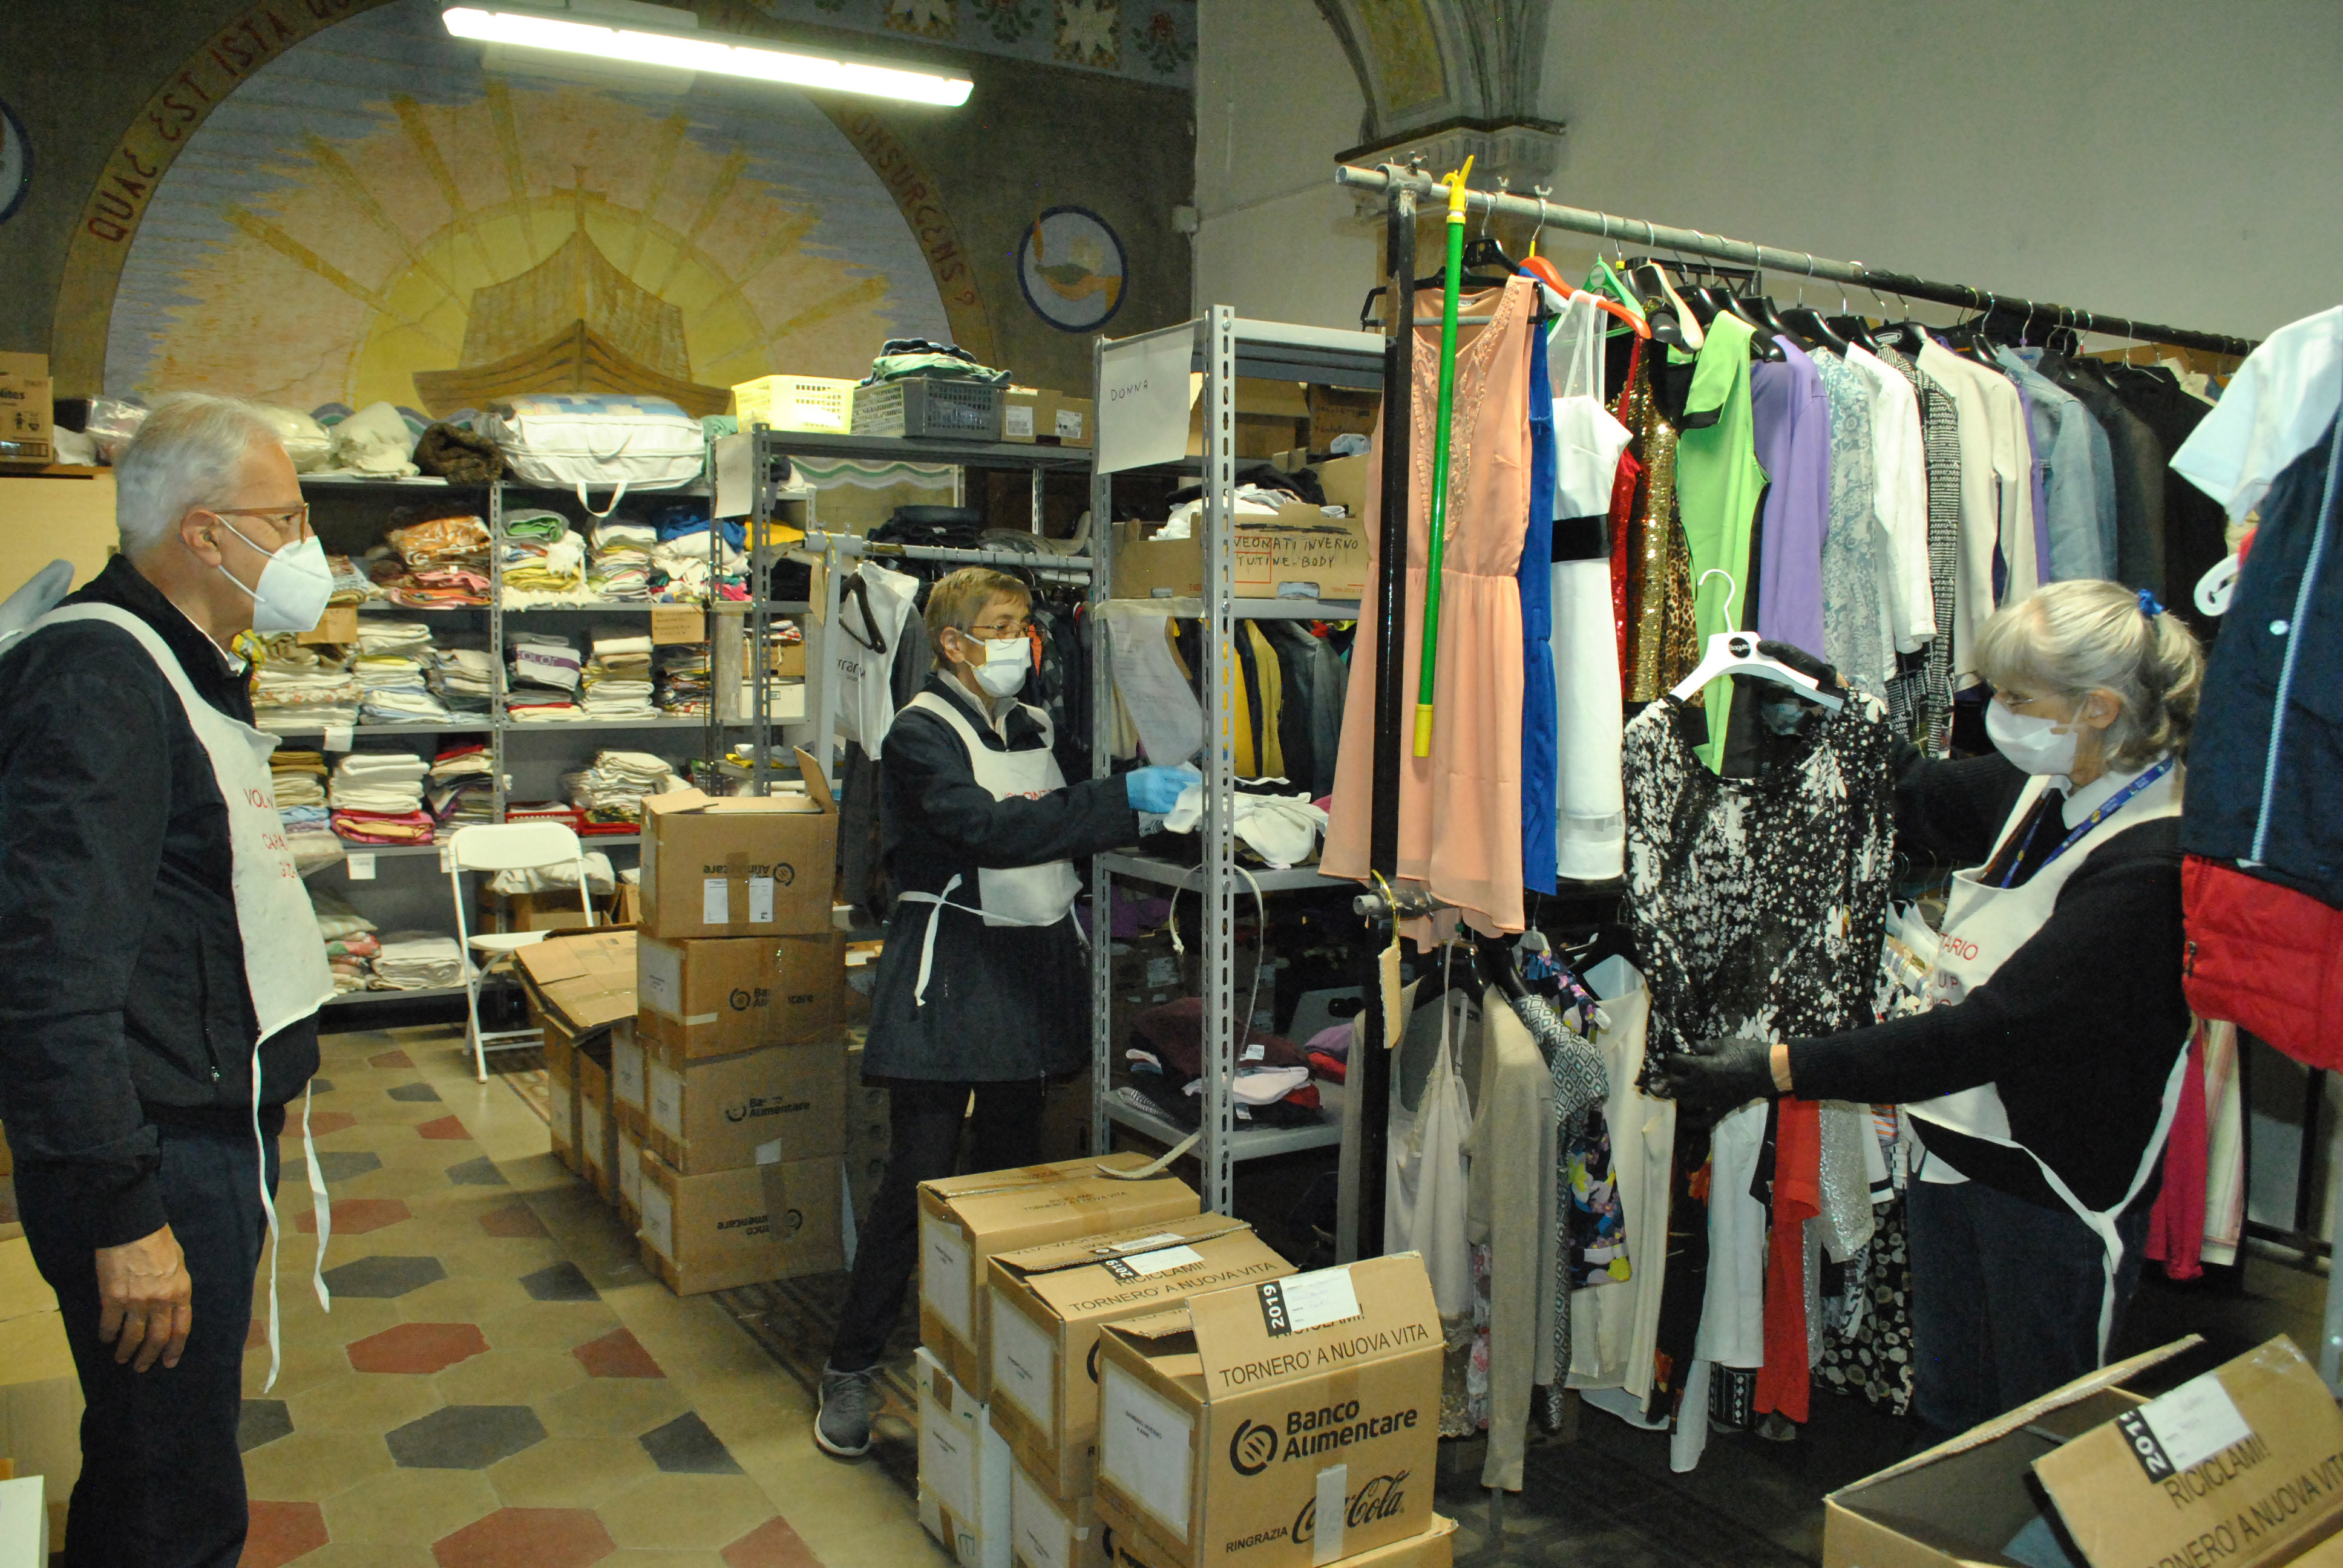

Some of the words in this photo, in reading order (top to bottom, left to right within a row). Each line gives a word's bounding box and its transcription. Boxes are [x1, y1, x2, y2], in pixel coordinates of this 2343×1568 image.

[1110, 379, 1148, 401] DONNA
[1302, 556, 1335, 568] BODY
[1304, 537, 1358, 550] INVERNO
[1068, 1286, 1159, 1312] TORNERO'
[1165, 1284, 1179, 1293] A
[1177, 1270, 1240, 1290] NUOVA
[1238, 1261, 1277, 1276] VITA
[1105, 1259, 1135, 1278] 2019
[1263, 1284, 1285, 1330] 2019
[1219, 1349, 1311, 1387] TORNERO'
[1317, 1347, 1329, 1365] A
[1330, 1332, 1391, 1362] NUOVA
[1390, 1323, 1429, 1346] VITA
[1282, 1408, 1418, 1463] Alimentare
[1286, 1399, 1360, 1436] Banco
[2237, 1514, 2261, 1543] A
[2249, 1474, 2322, 1532] NUOVA
[1225, 1526, 1288, 1553] RINGRAZIA
